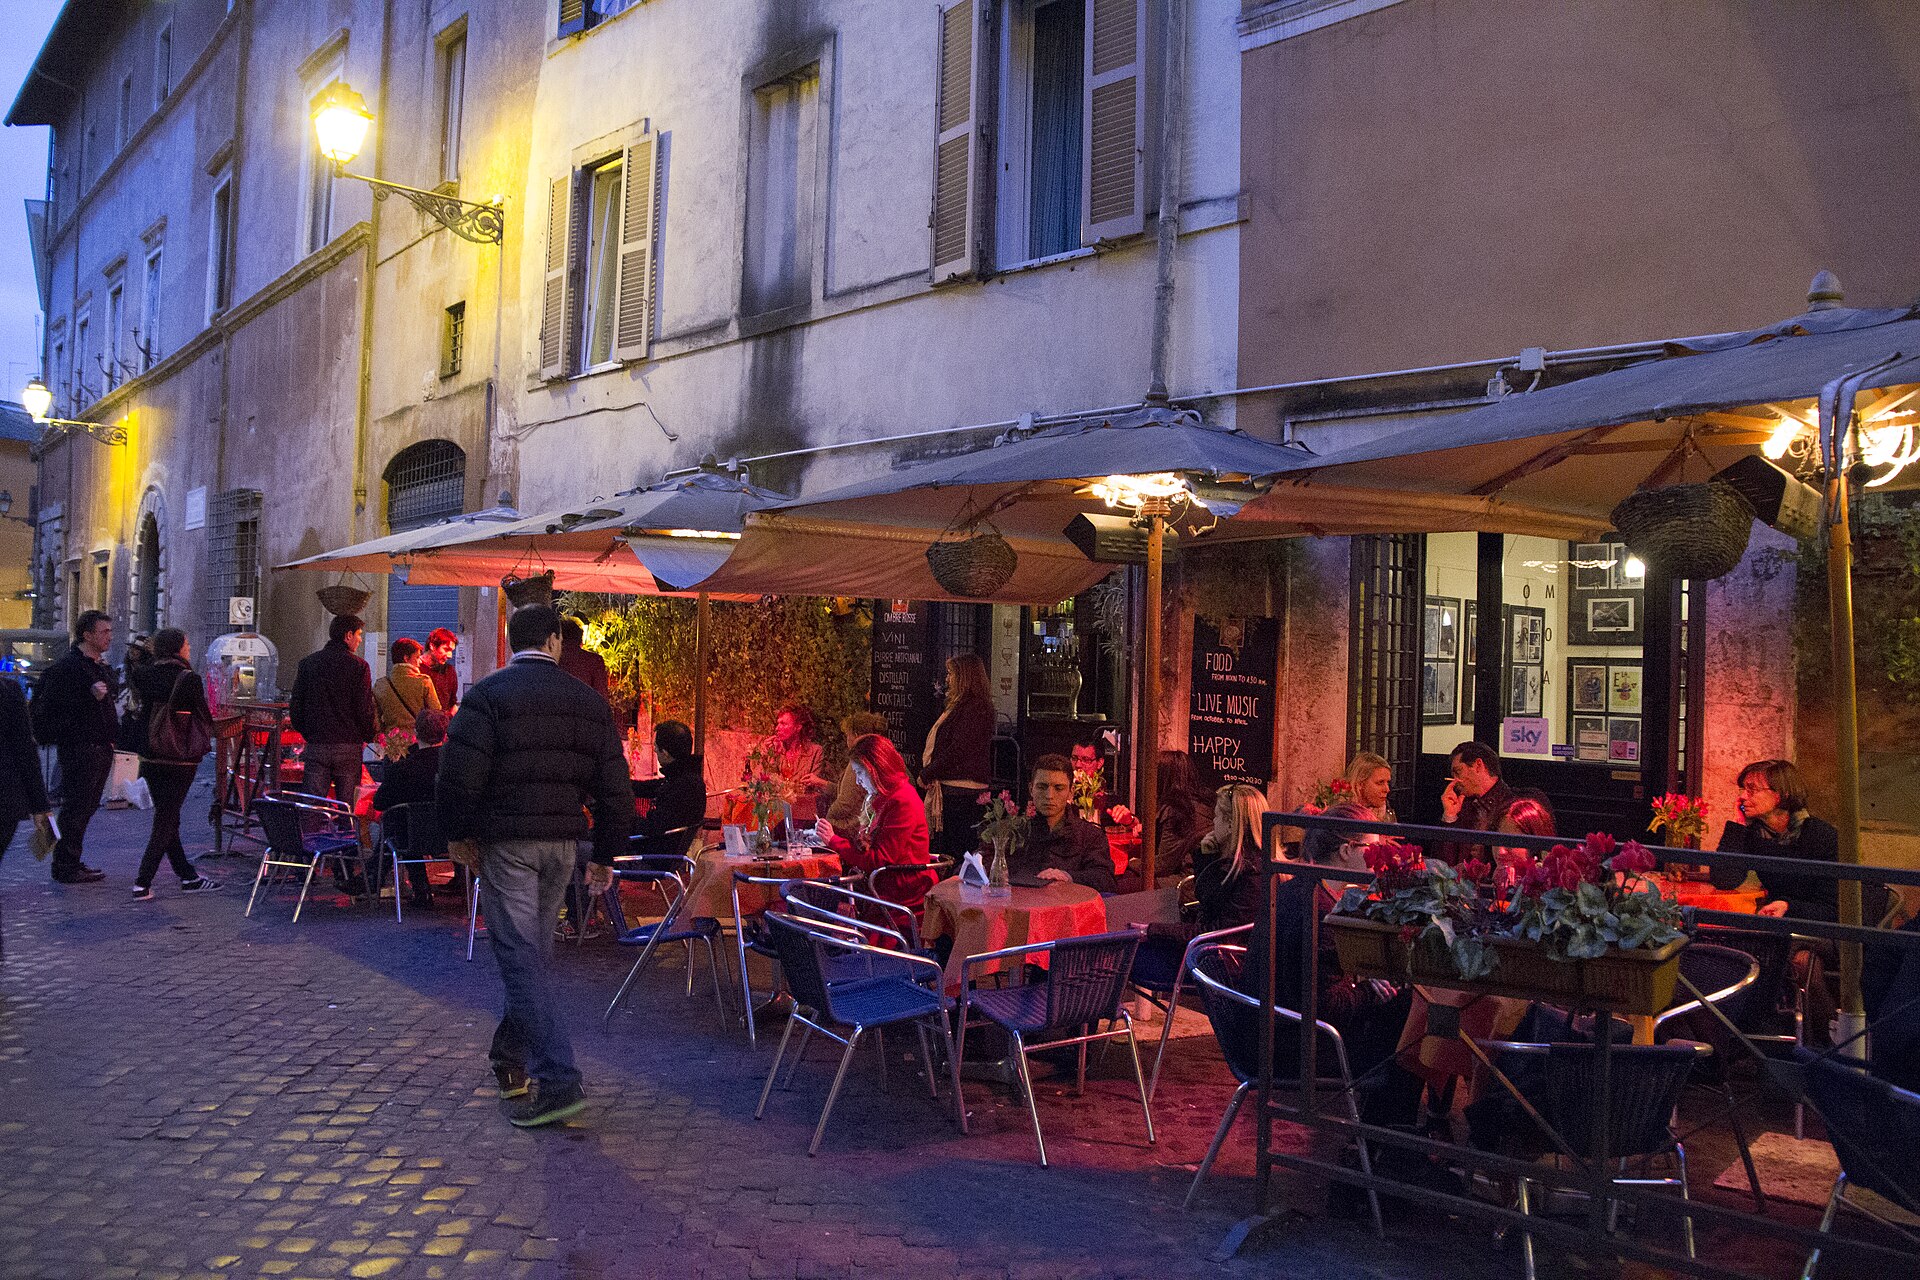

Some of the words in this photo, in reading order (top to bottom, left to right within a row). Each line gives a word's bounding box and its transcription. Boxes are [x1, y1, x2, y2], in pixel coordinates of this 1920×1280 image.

[881, 631, 906, 645] VINI
[874, 651, 894, 663] BIRRE
[1205, 652, 1233, 672] FOOD
[1211, 673, 1224, 681] FROM
[1238, 674, 1246, 684] TO
[877, 693, 913, 708] COCKTAILS
[1197, 692, 1222, 713] LIVE
[1226, 694, 1260, 719] MUSIC
[1510, 725, 1543, 747] sky
[1193, 735, 1242, 756] HAPPY
[1213, 755, 1247, 772] HOUR
